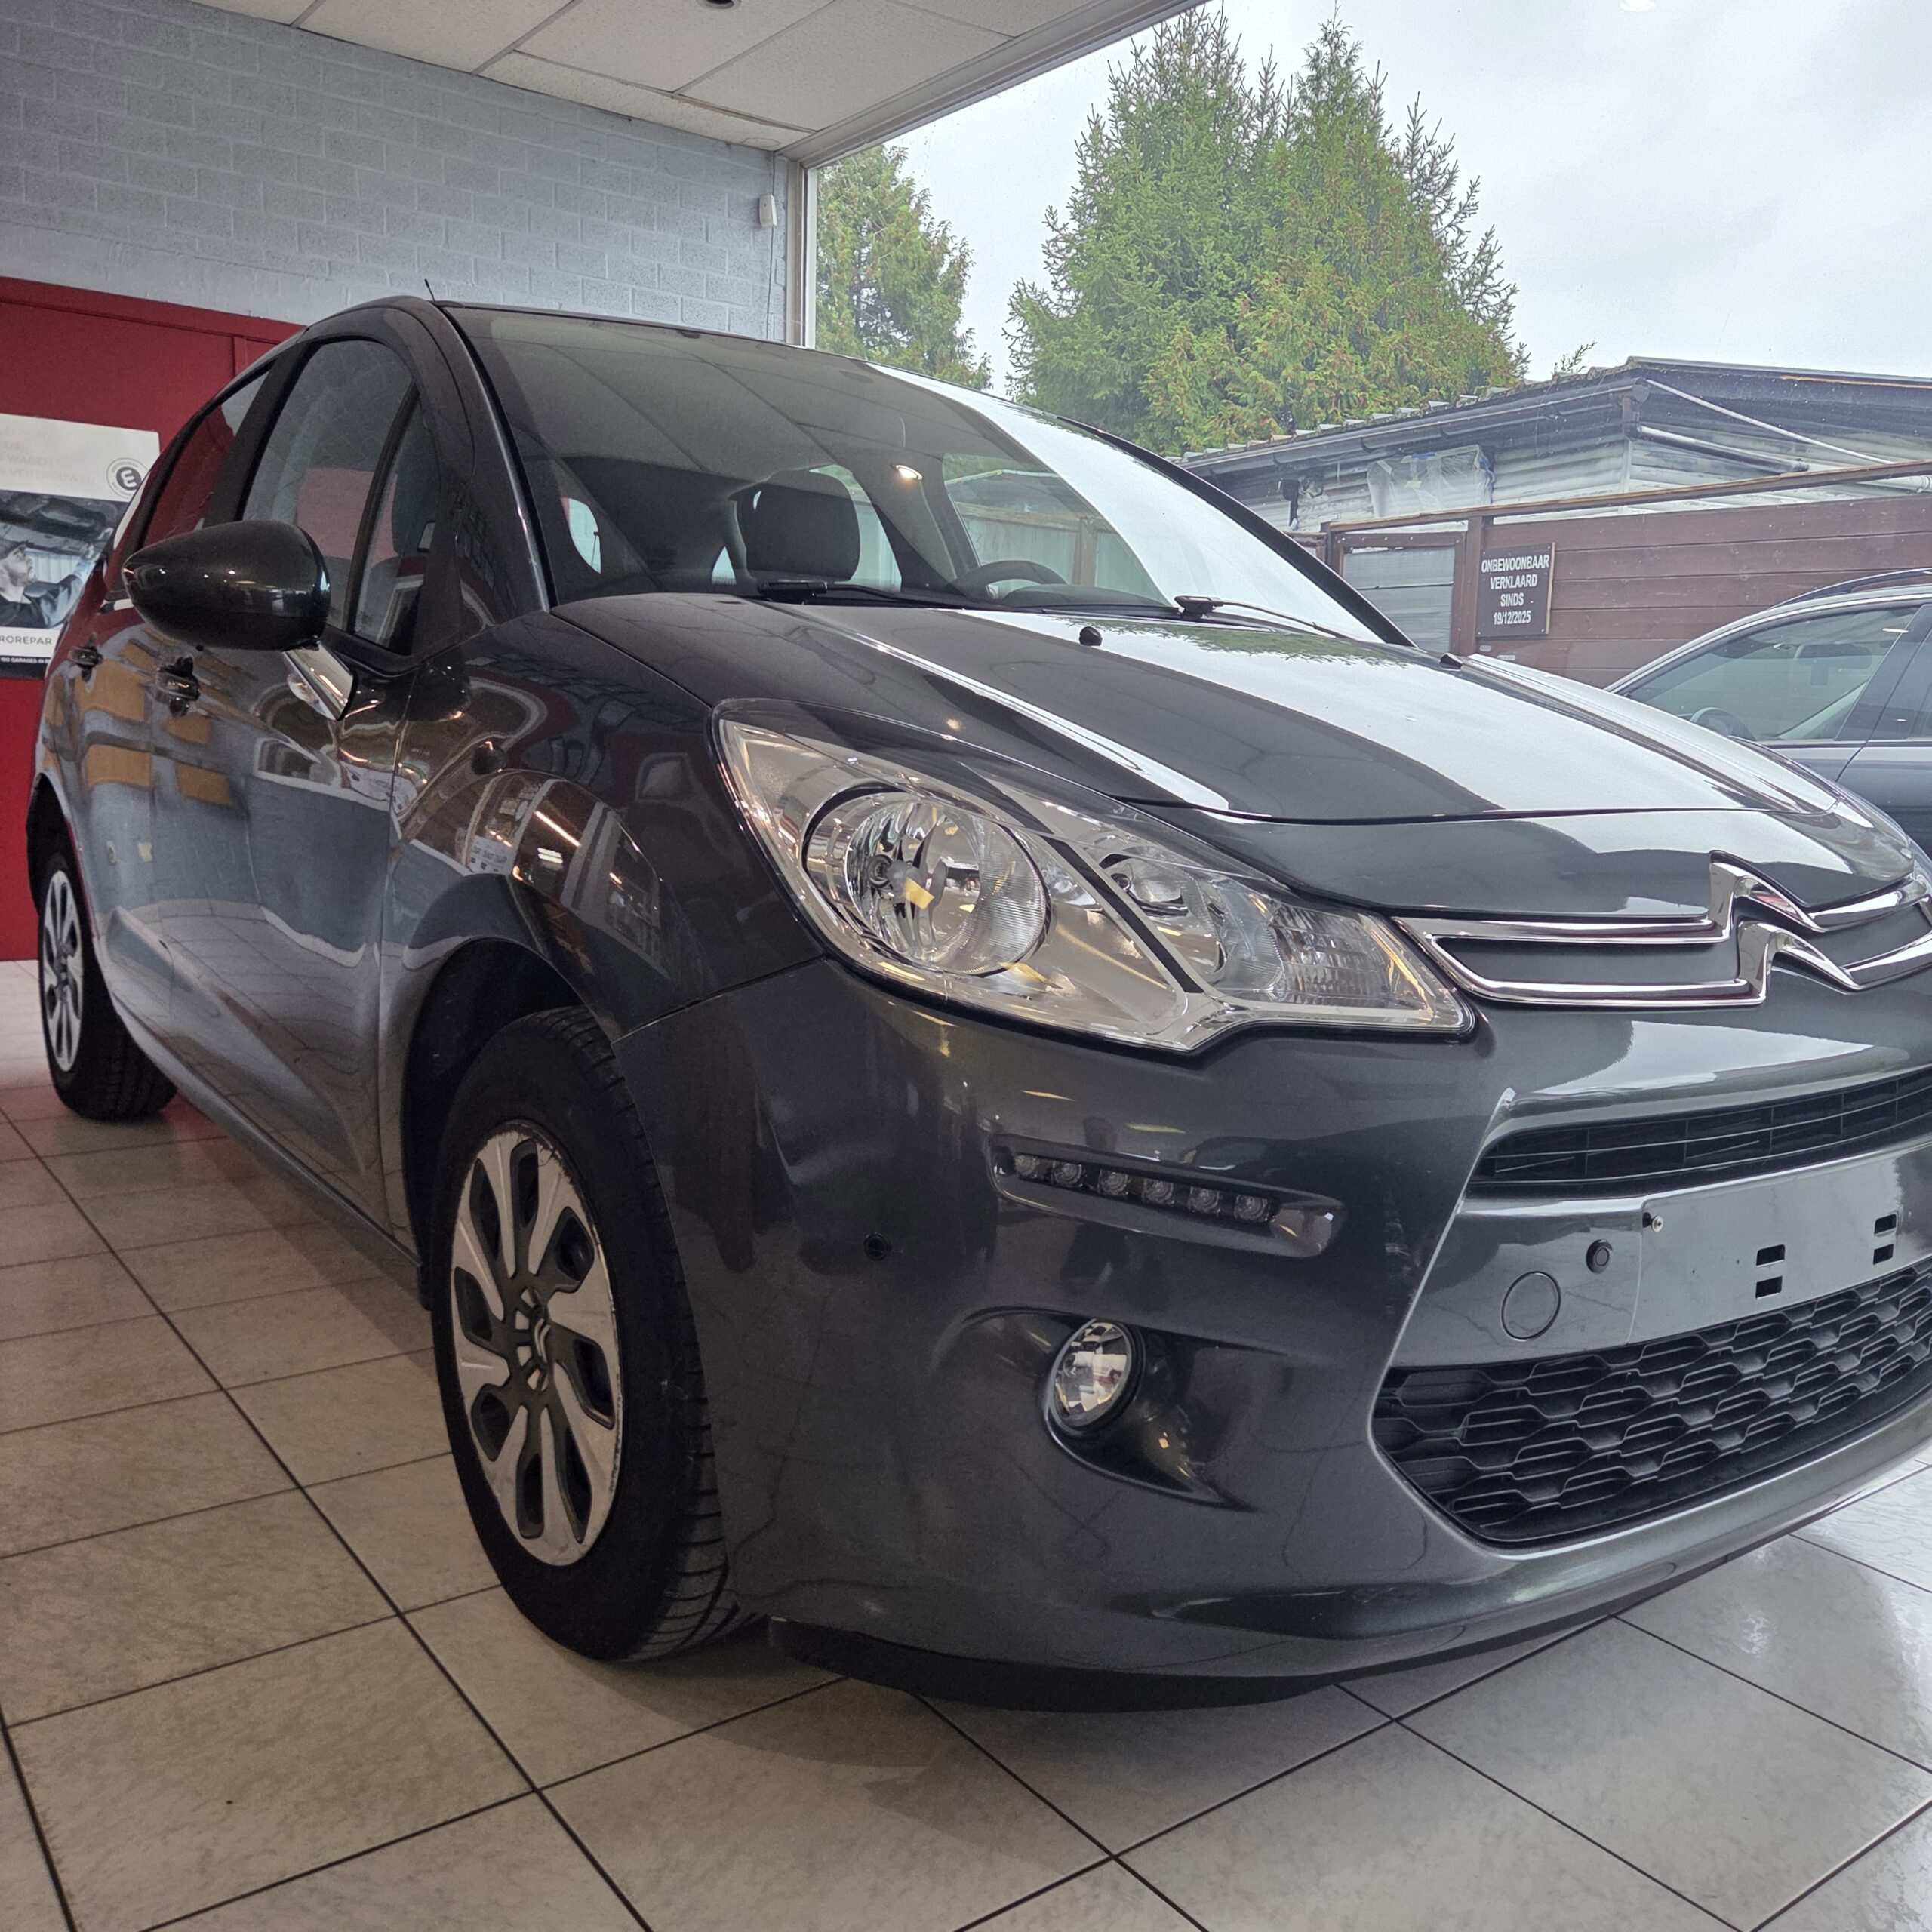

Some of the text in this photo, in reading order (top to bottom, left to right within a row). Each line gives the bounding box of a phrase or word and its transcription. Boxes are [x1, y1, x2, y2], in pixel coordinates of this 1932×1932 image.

[1481, 555, 1549, 573] ONBEWOONBAAR
[1490, 574, 1538, 589] VERKLAARD
[1500, 592, 1524, 607] SINDS
[1494, 610, 1531, 625] 19/12/2025
